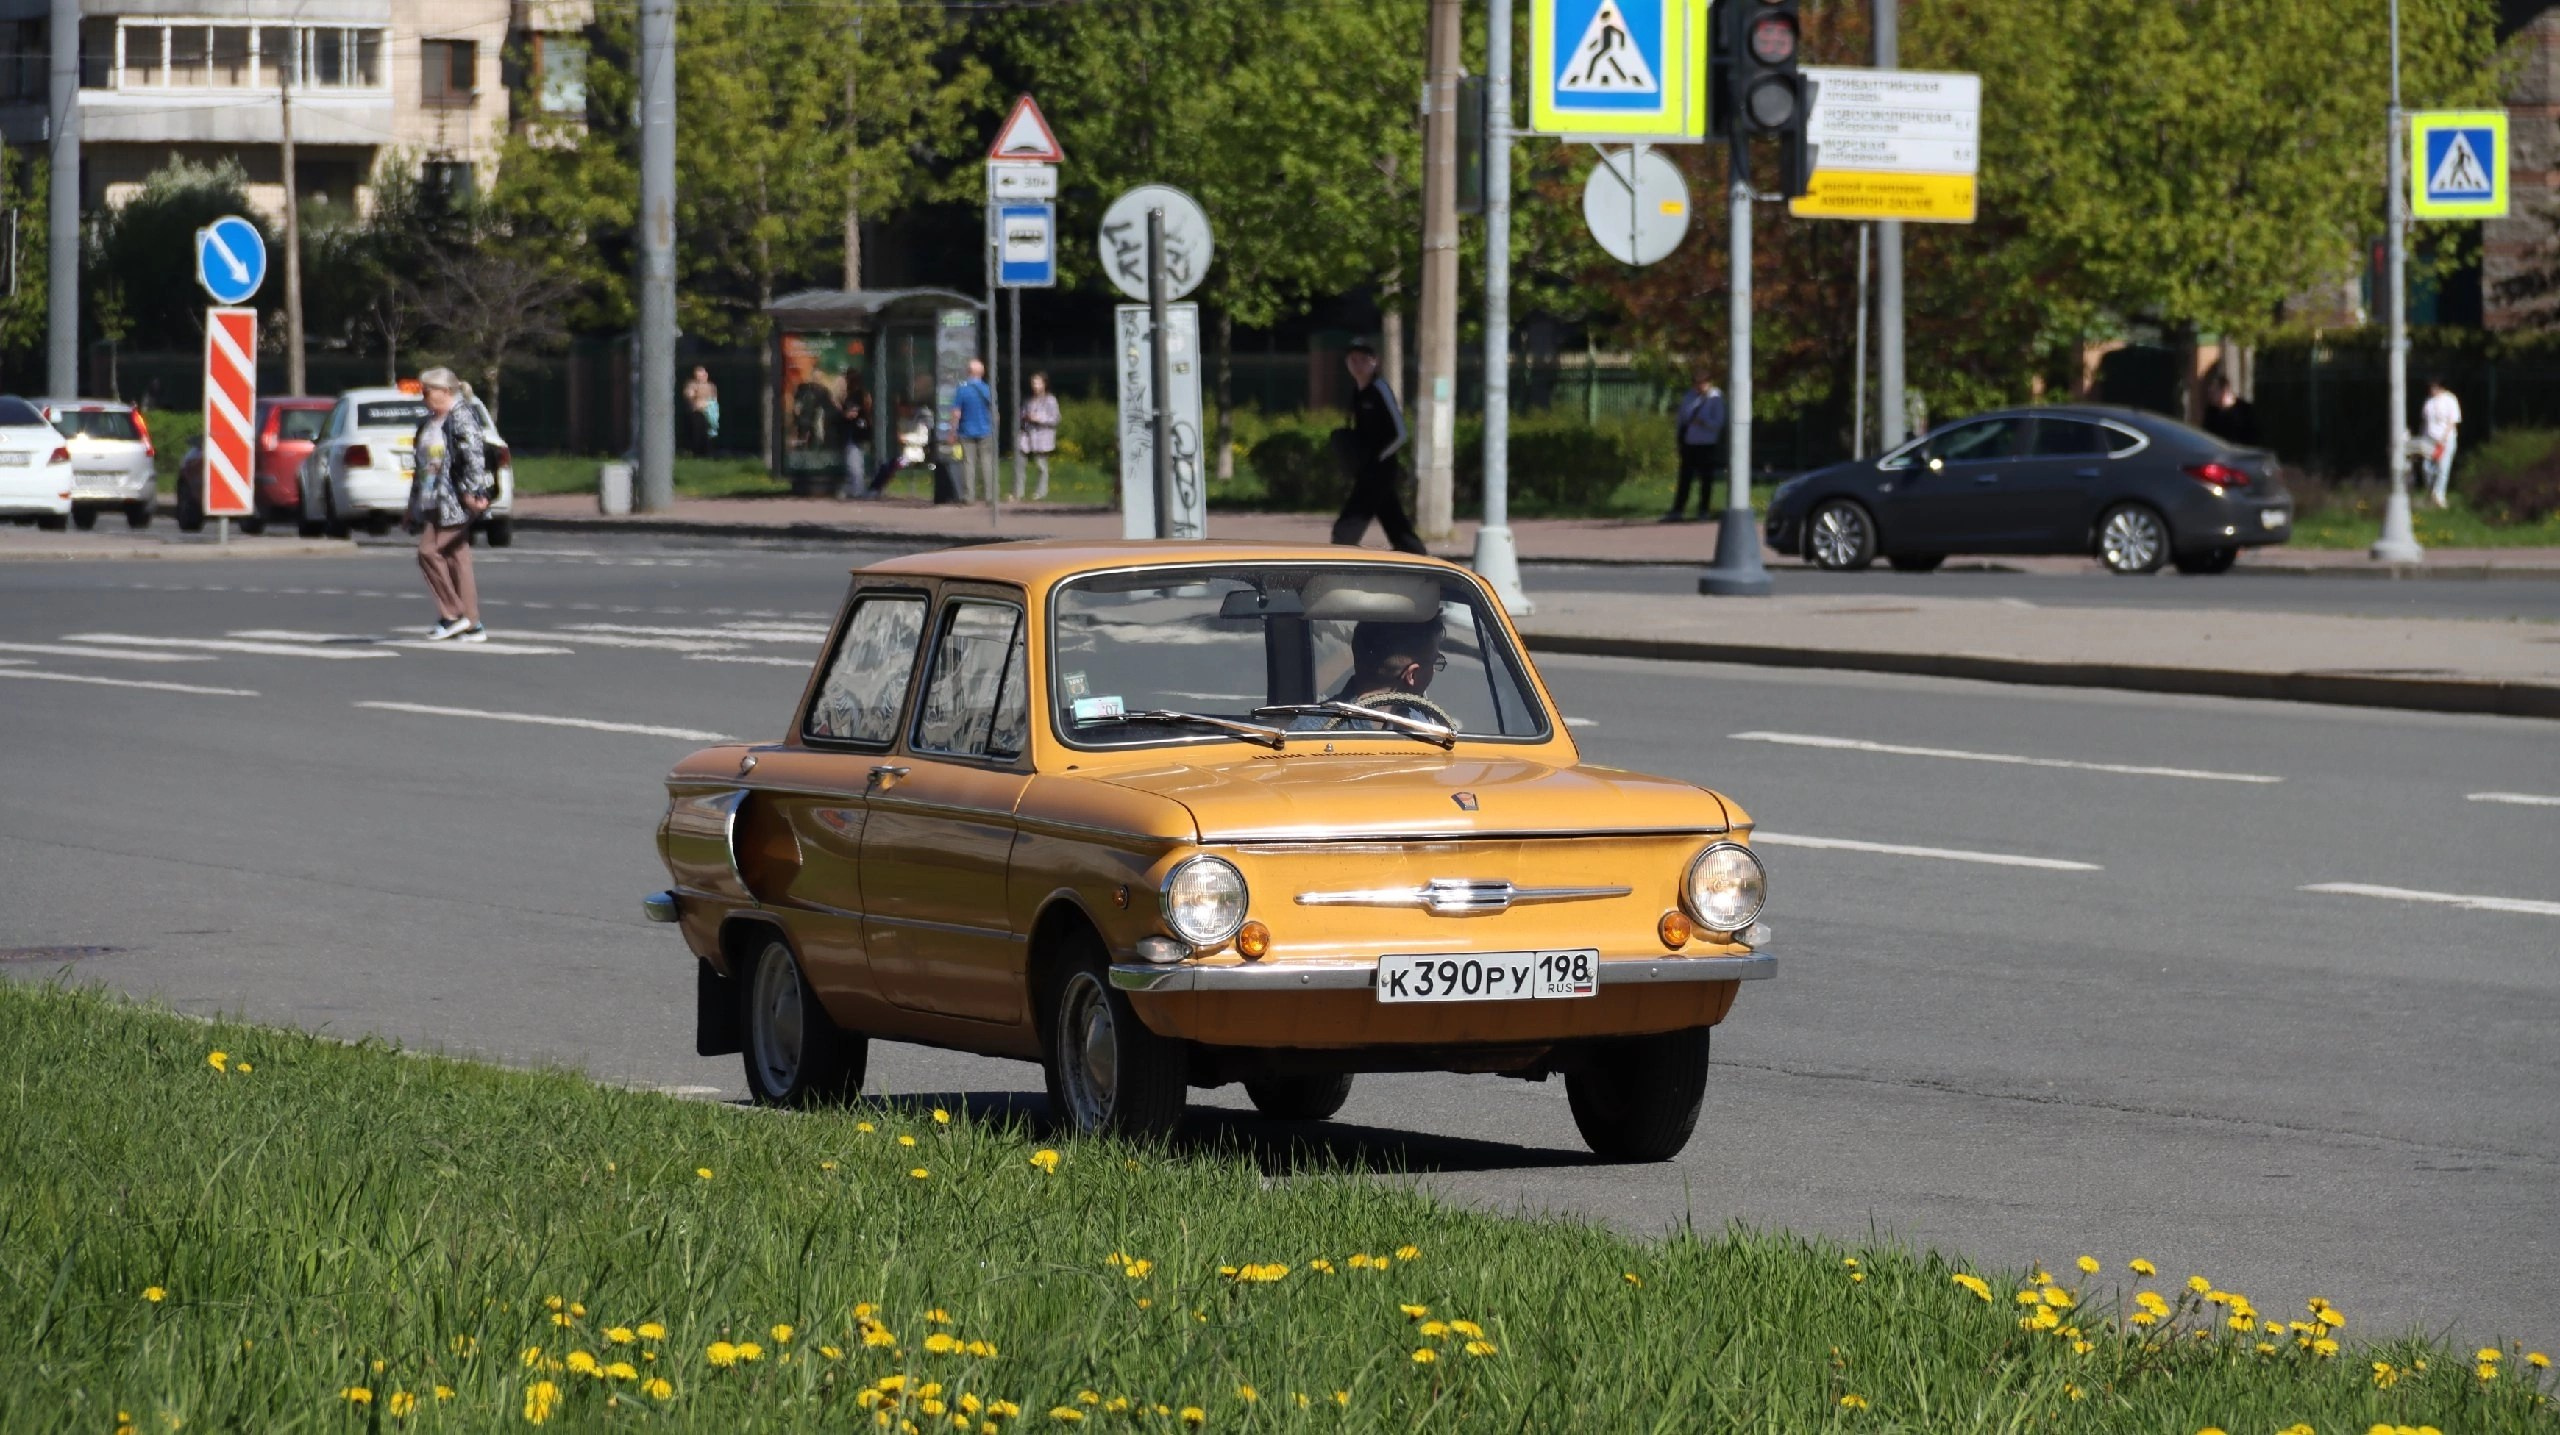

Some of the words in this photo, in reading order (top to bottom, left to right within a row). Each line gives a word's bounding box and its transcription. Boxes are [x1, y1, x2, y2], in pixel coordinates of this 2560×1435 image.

[1390, 959, 1530, 997] К390РУ
[1539, 954, 1588, 982] 198
[1547, 982, 1573, 993] RUS
